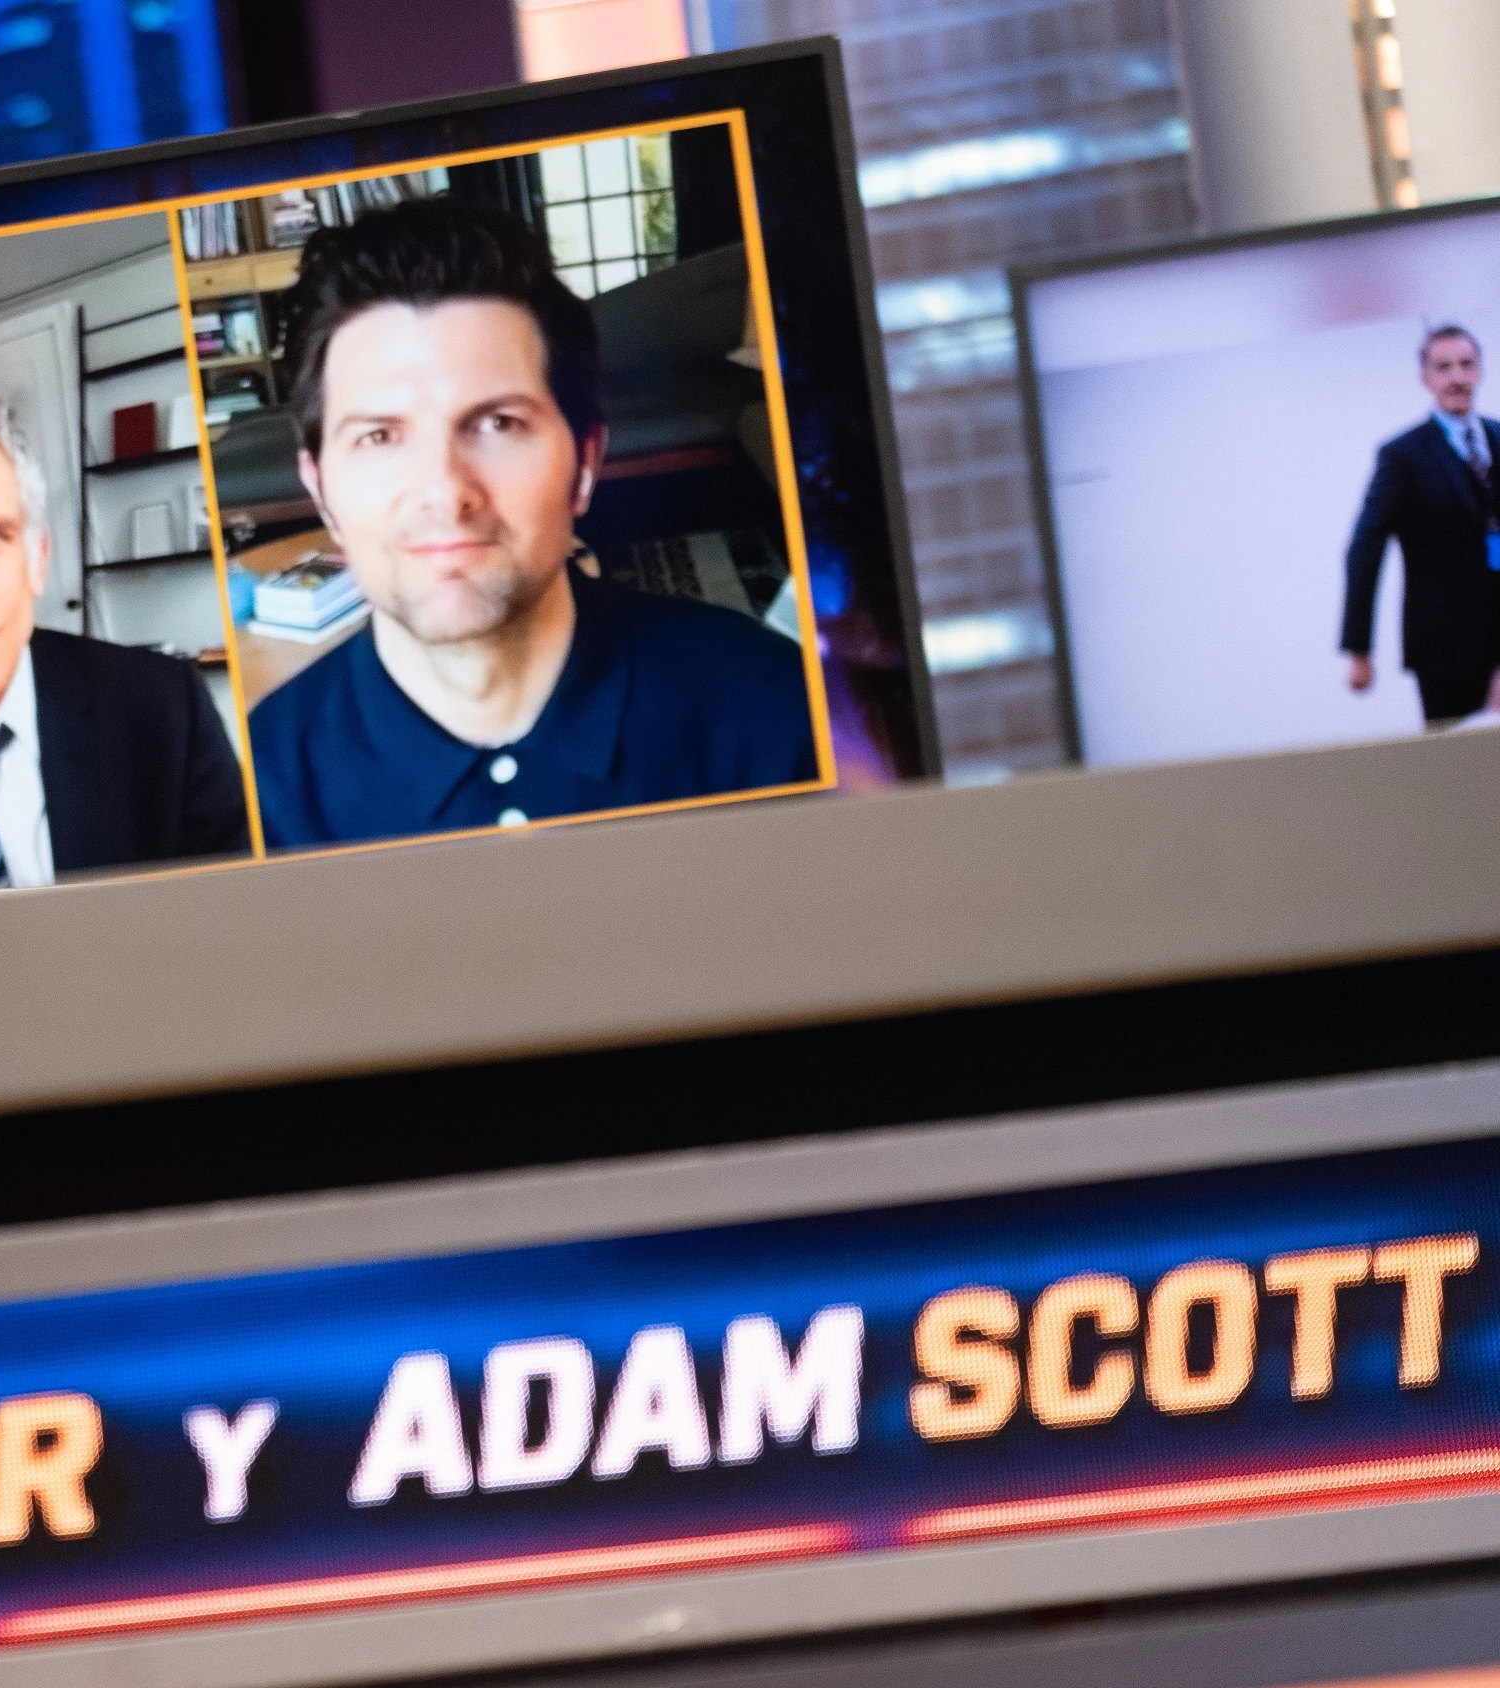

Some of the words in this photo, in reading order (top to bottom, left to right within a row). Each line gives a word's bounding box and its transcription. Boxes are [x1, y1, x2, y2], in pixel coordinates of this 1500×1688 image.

[184, 1401, 278, 1523] Y
[349, 1305, 863, 1506] ADAM
[908, 1232, 1479, 1442] SCOTT
